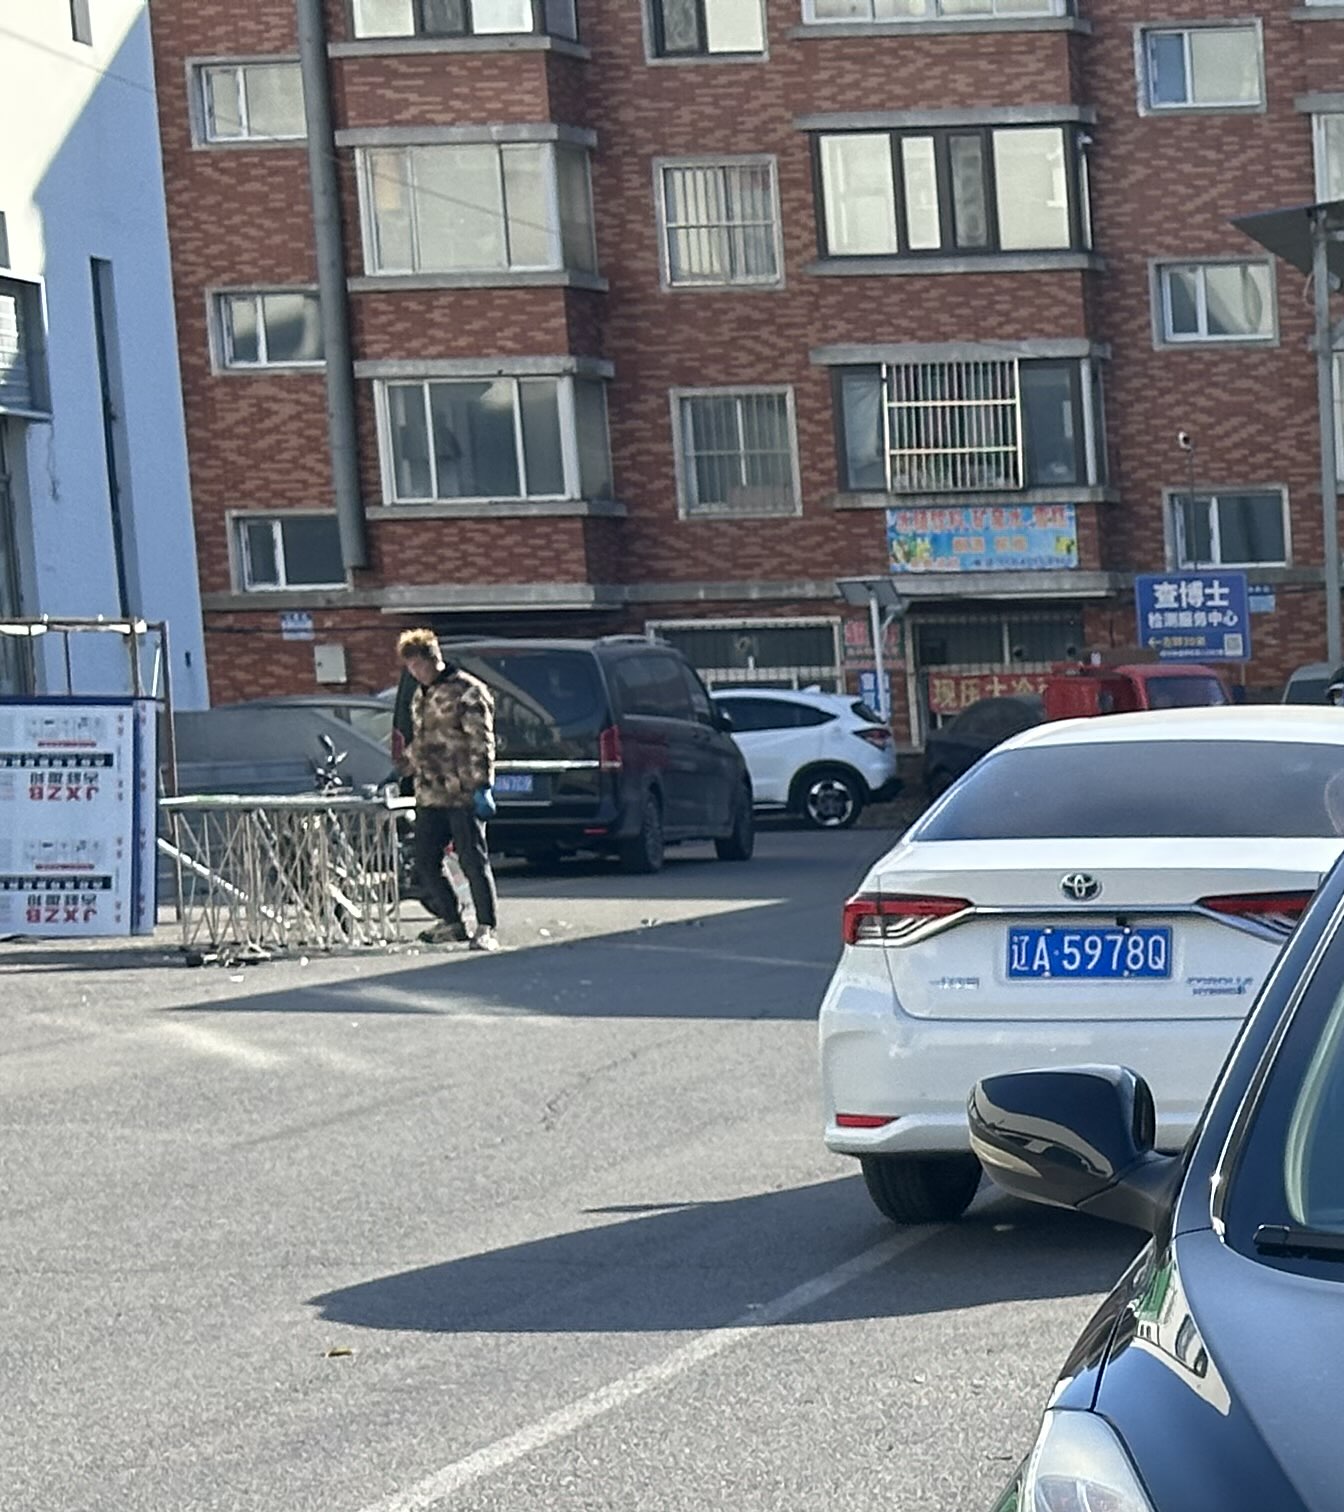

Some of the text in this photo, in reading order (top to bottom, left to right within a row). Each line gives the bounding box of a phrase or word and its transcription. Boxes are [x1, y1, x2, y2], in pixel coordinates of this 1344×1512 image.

[1152, 579, 1231, 609] 查博士
[28, 785, 99, 802] JXZB
[25, 908, 97, 925] JXZB
